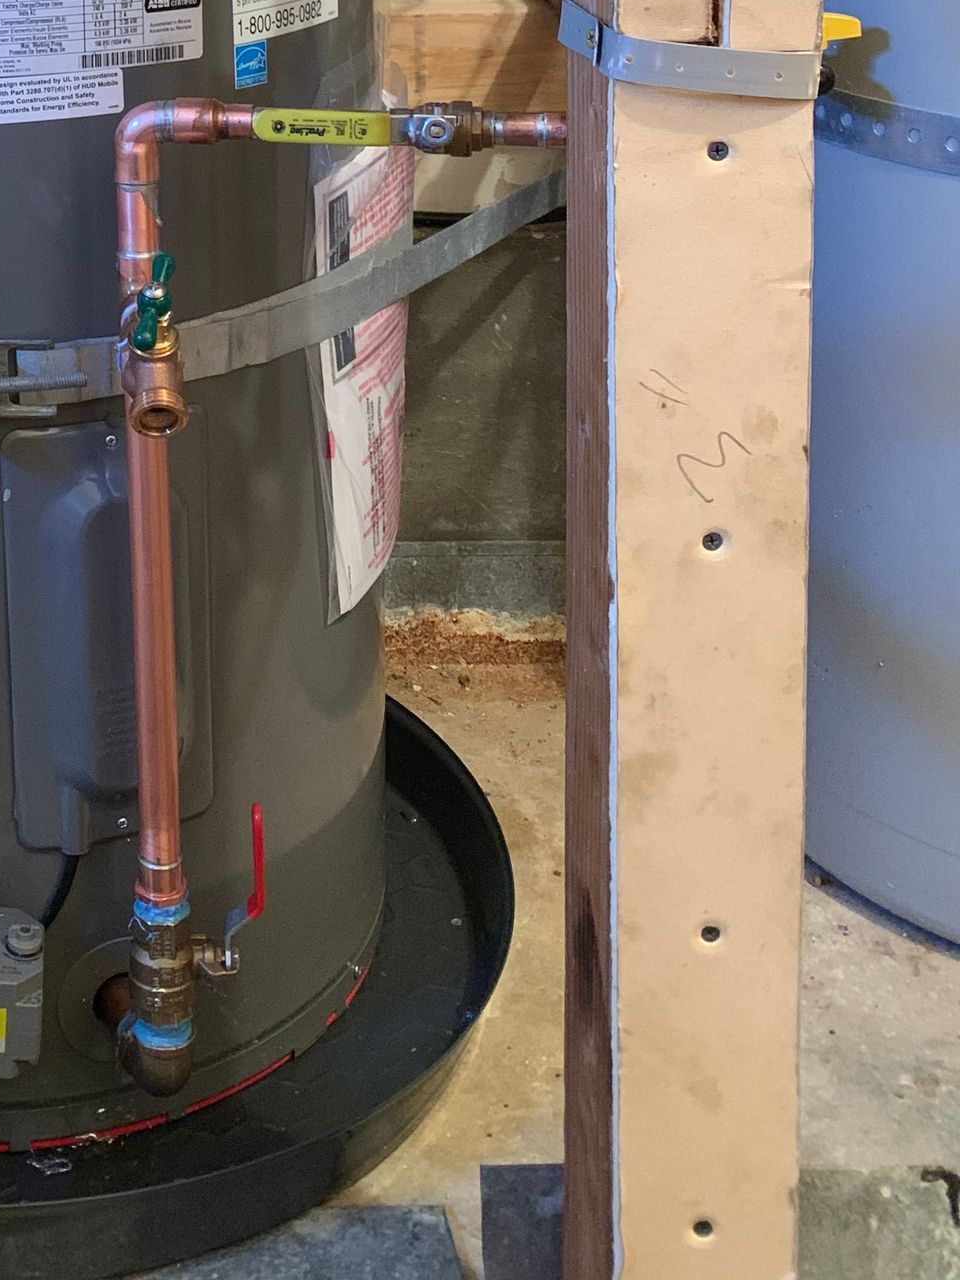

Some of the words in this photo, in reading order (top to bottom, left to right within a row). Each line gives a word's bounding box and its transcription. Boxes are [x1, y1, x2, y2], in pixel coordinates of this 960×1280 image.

[238, 0, 322, 37] 1-800-995-0982
[20, 78, 51, 87] evaluated
[82, 72, 118, 80] accordance
[16, 94, 60, 104] Construction
[43, 103, 66, 111] Energy
